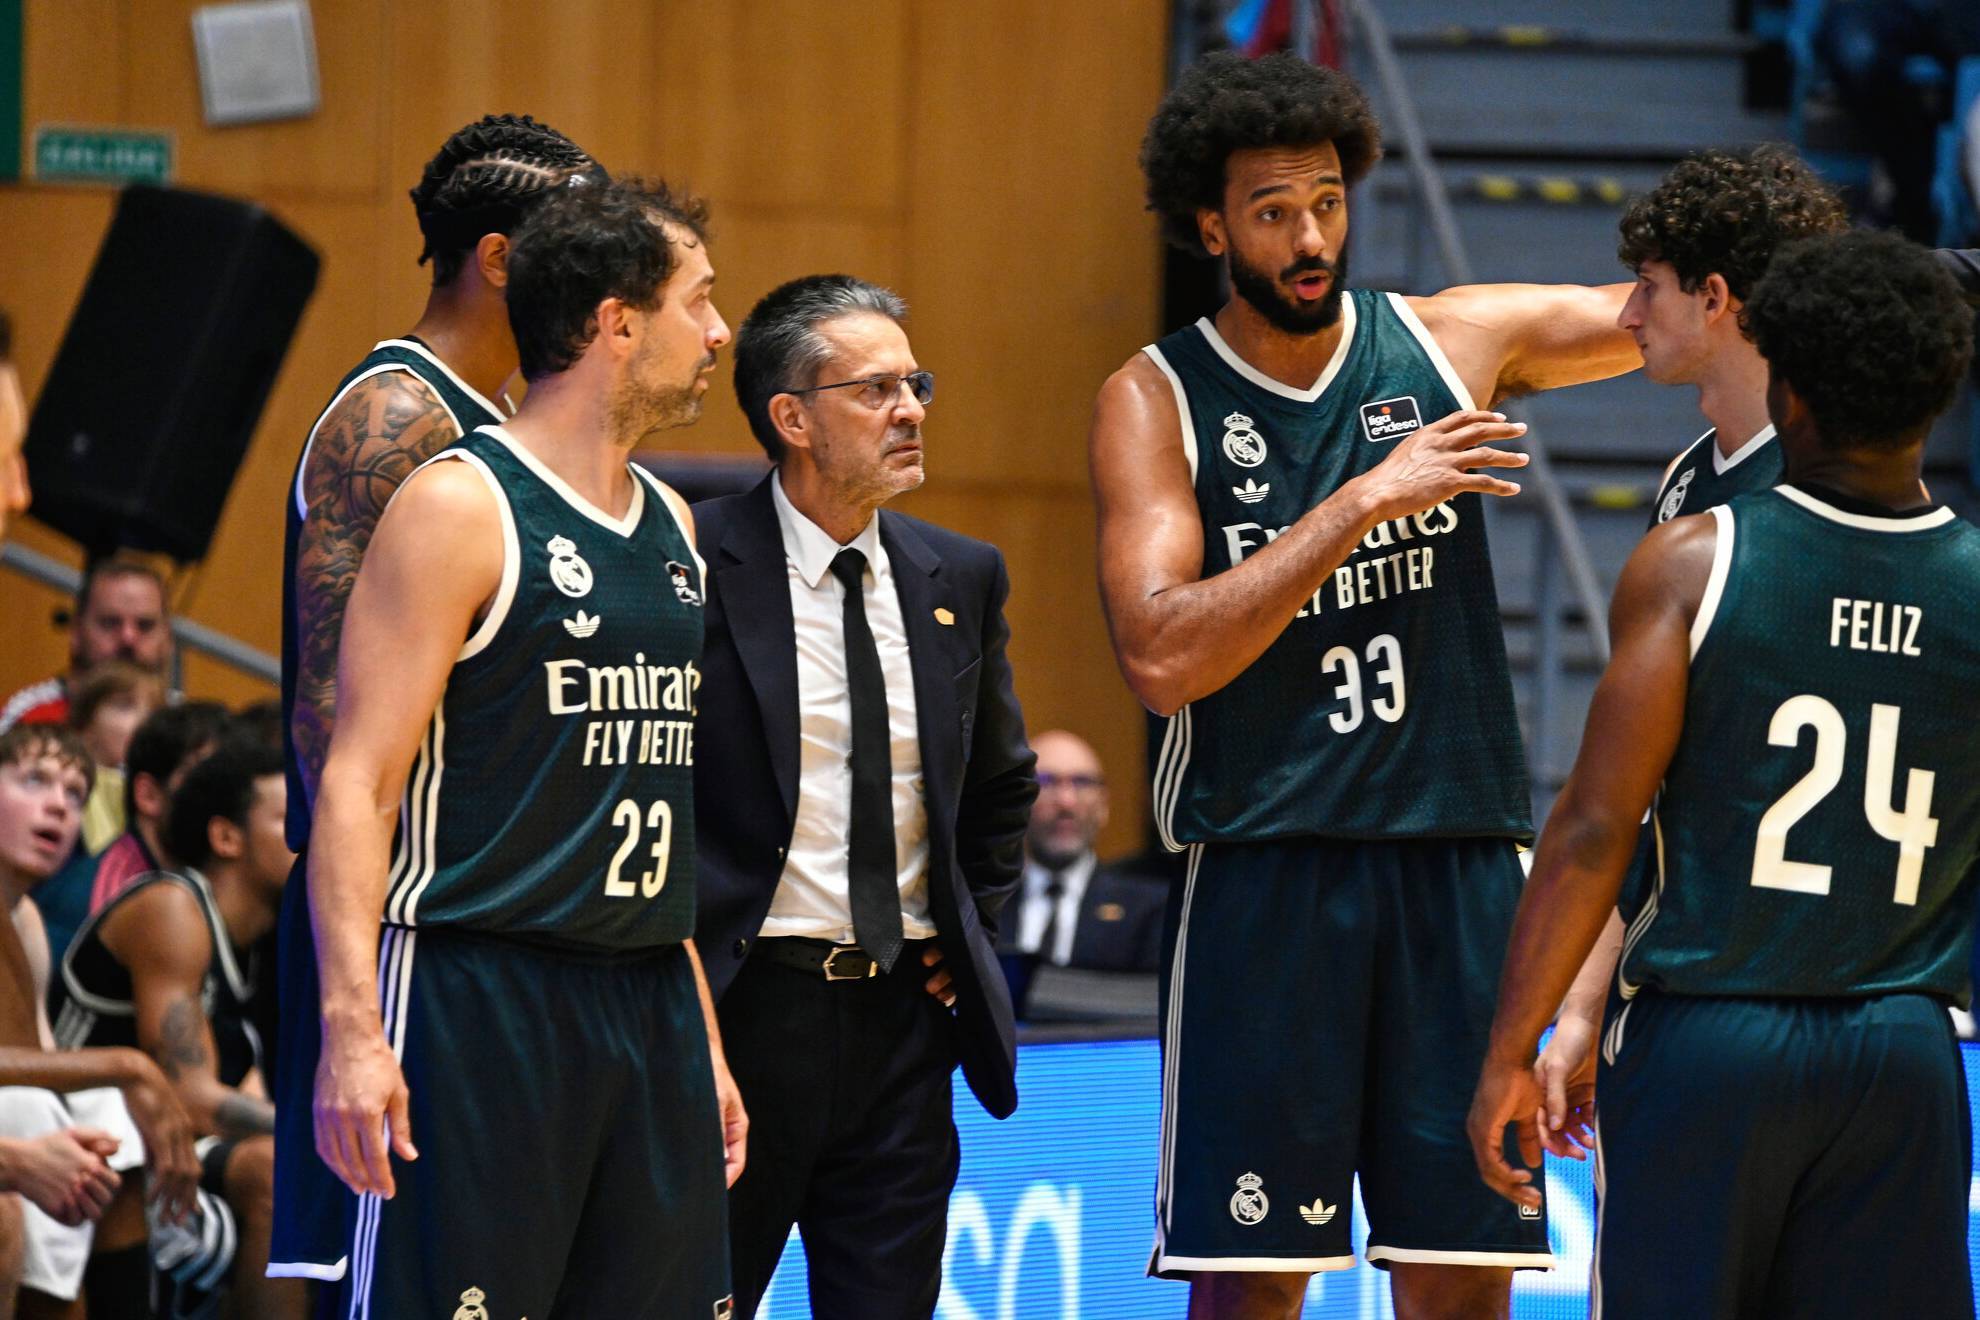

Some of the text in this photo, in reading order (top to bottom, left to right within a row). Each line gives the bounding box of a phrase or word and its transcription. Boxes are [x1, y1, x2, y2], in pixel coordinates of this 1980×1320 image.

[1367, 414, 1391, 426] liga
[1371, 420, 1418, 435] endesa
[1335, 546, 1434, 610] BETTER
[1830, 597, 1922, 656] FELIZ
[1321, 633, 1406, 734] 33
[583, 720, 635, 766] FLY
[1750, 694, 1939, 906] 24
[604, 798, 672, 899] 23
